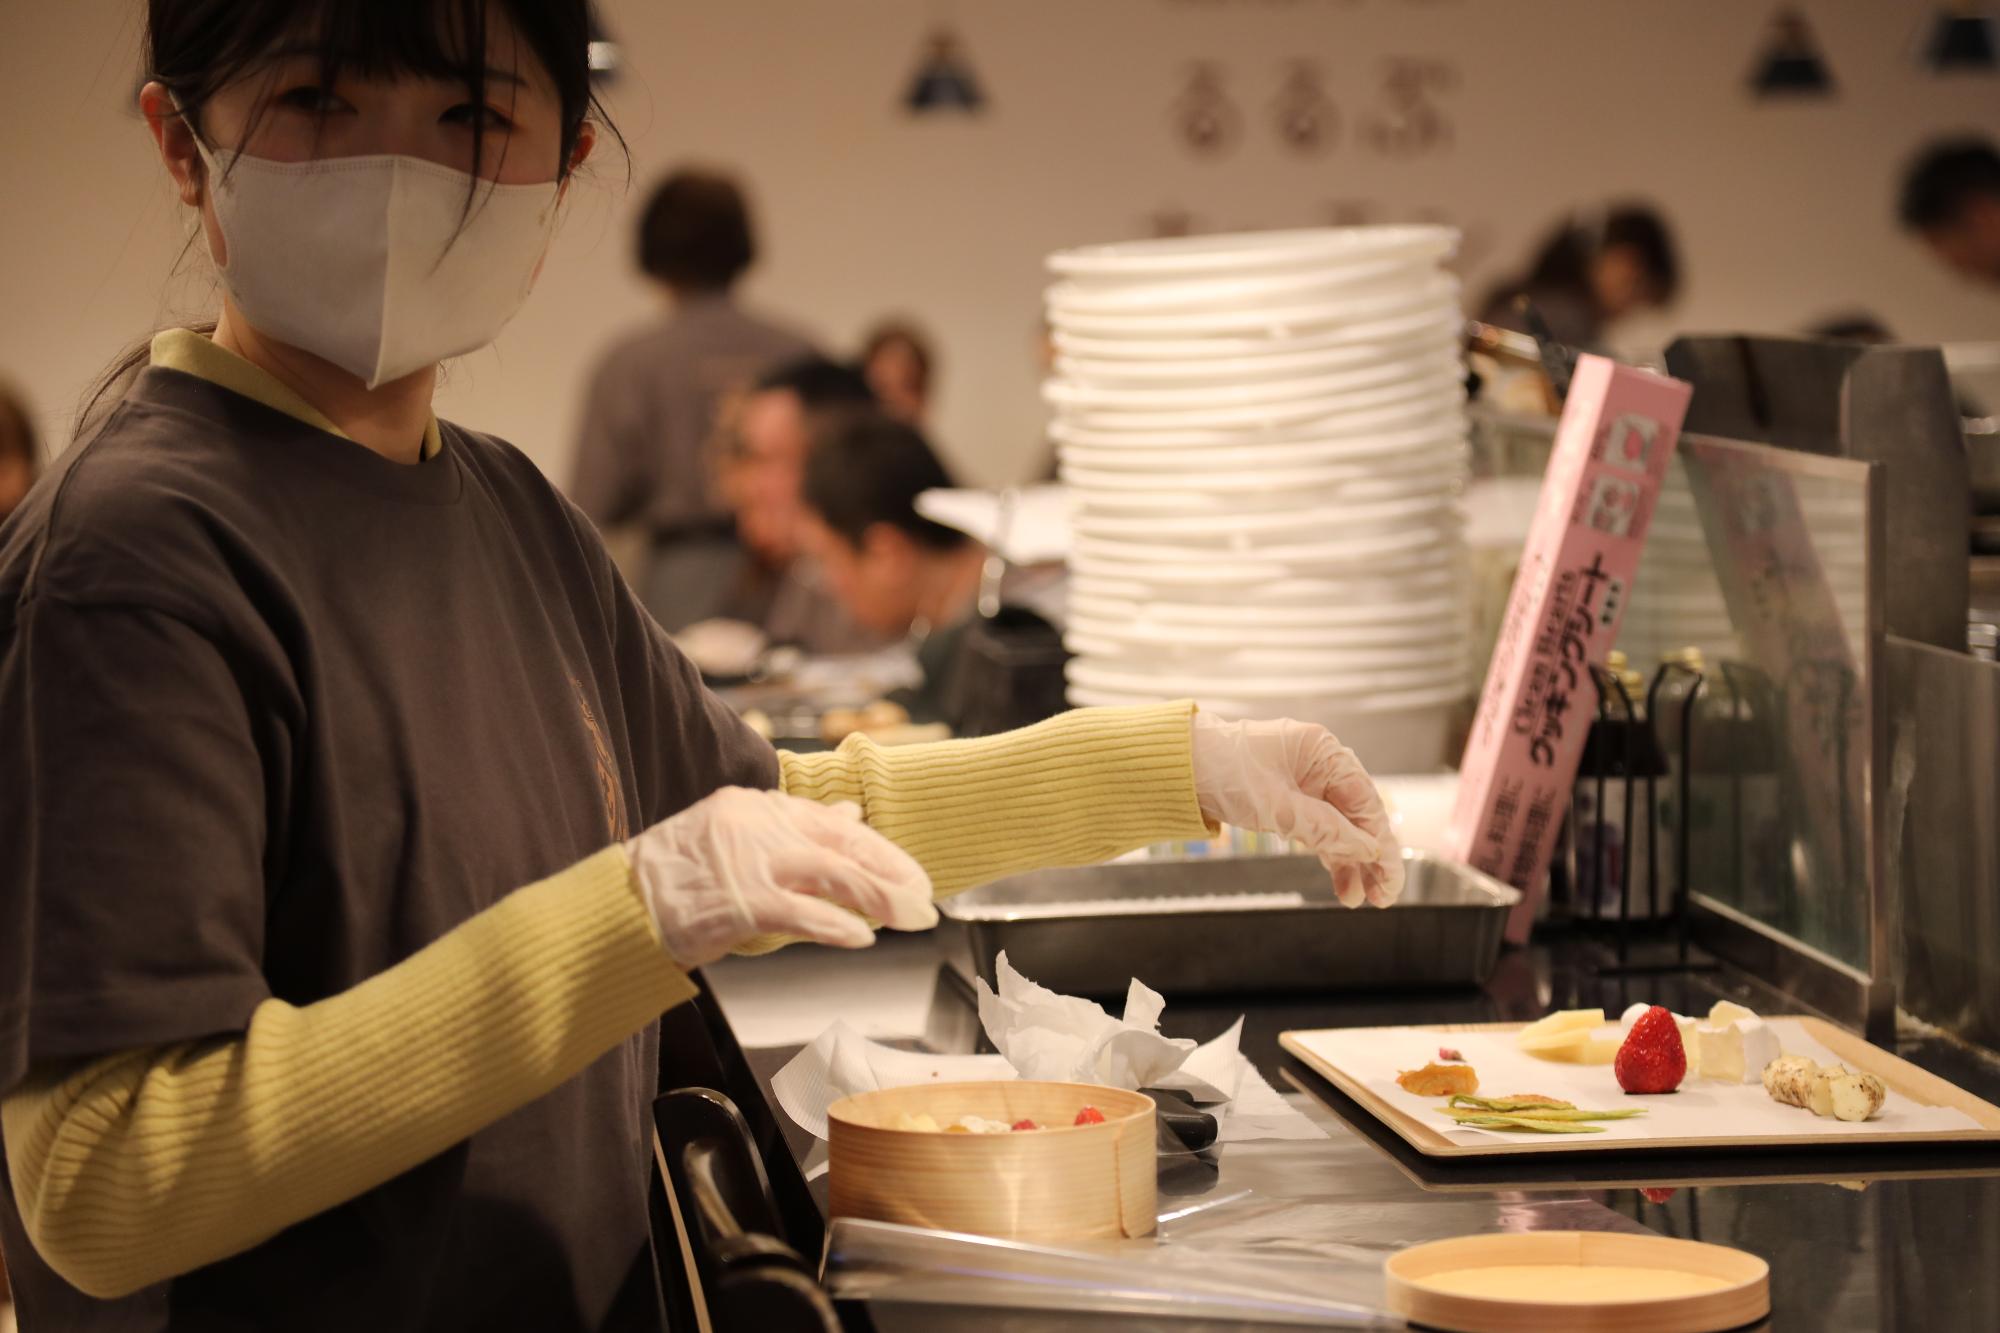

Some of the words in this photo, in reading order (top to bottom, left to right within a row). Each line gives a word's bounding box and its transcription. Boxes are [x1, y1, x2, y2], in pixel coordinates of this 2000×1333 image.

[1529, 552, 1610, 769] クッキングシート
